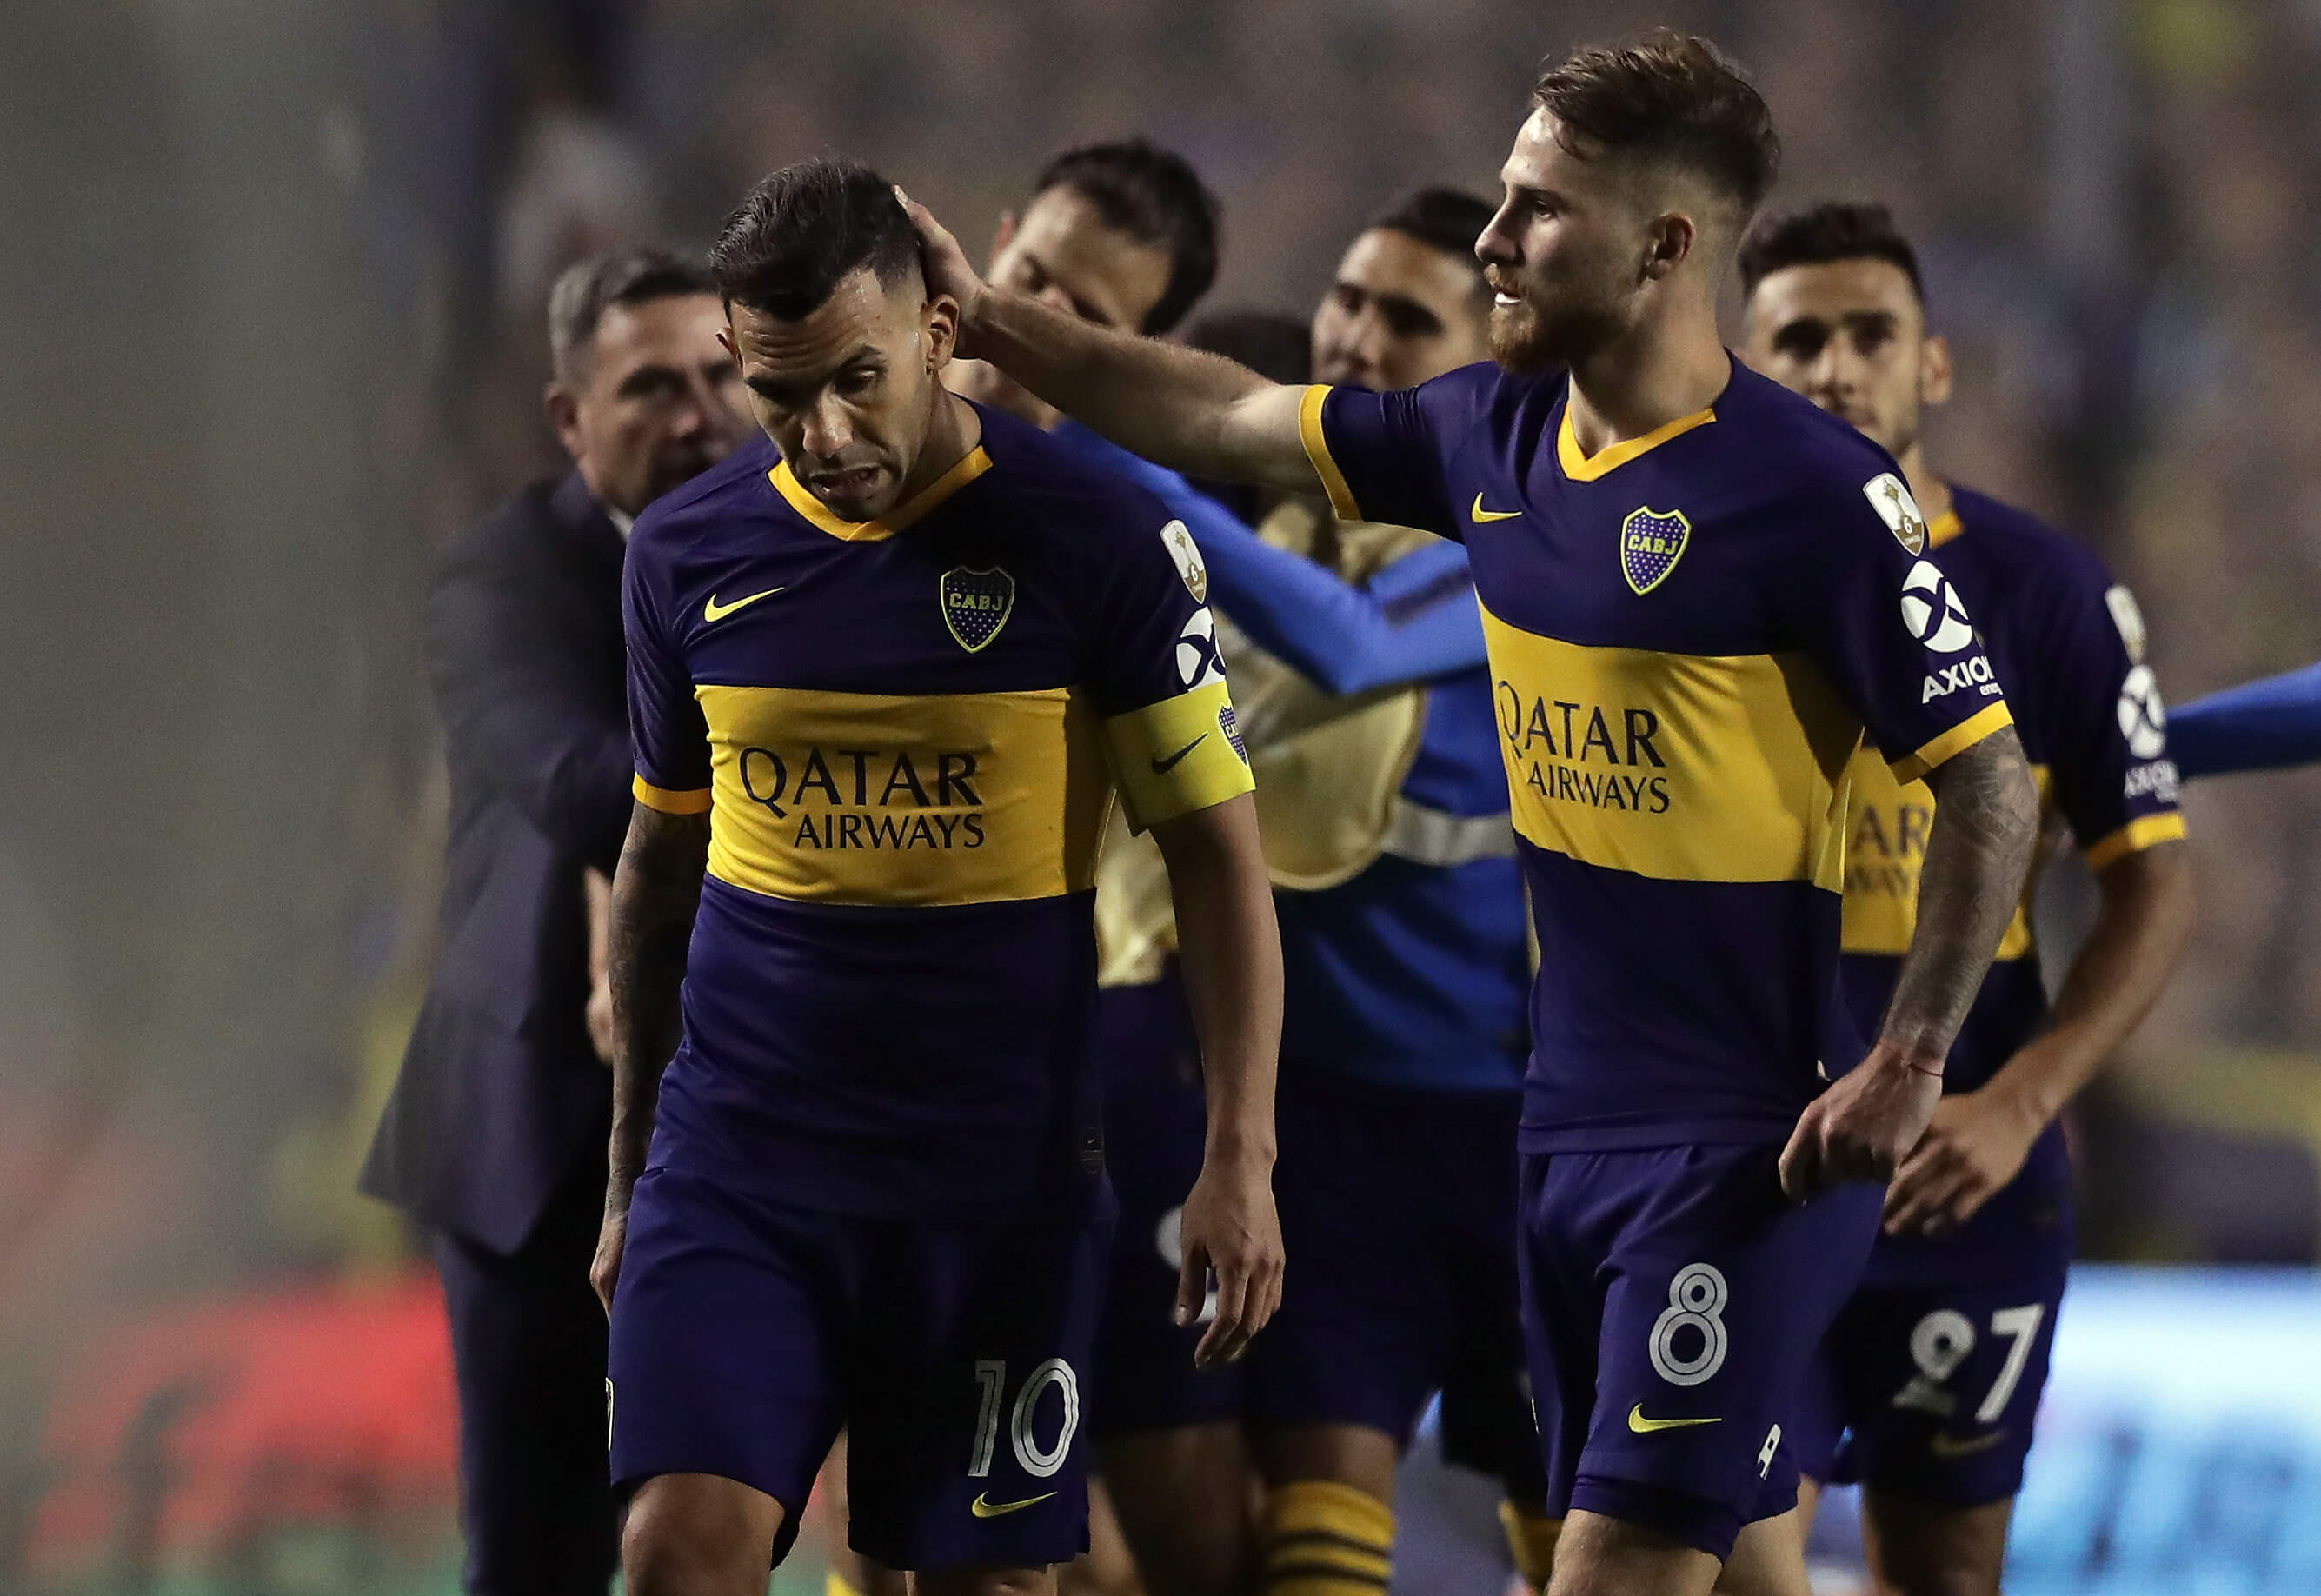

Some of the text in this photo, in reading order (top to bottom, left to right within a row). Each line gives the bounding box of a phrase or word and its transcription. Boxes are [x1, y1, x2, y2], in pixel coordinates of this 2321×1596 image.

[1628, 535, 1679, 555] CABJ
[950, 592, 1003, 611] CABJ
[1499, 680, 1666, 768] QATAR
[740, 747, 983, 820] QATAR
[1528, 761, 1670, 814] AIRWAYS
[795, 813, 985, 850] AIRWAYS
[1649, 1262, 1728, 1386] 8
[968, 1357, 1080, 1478] 10
